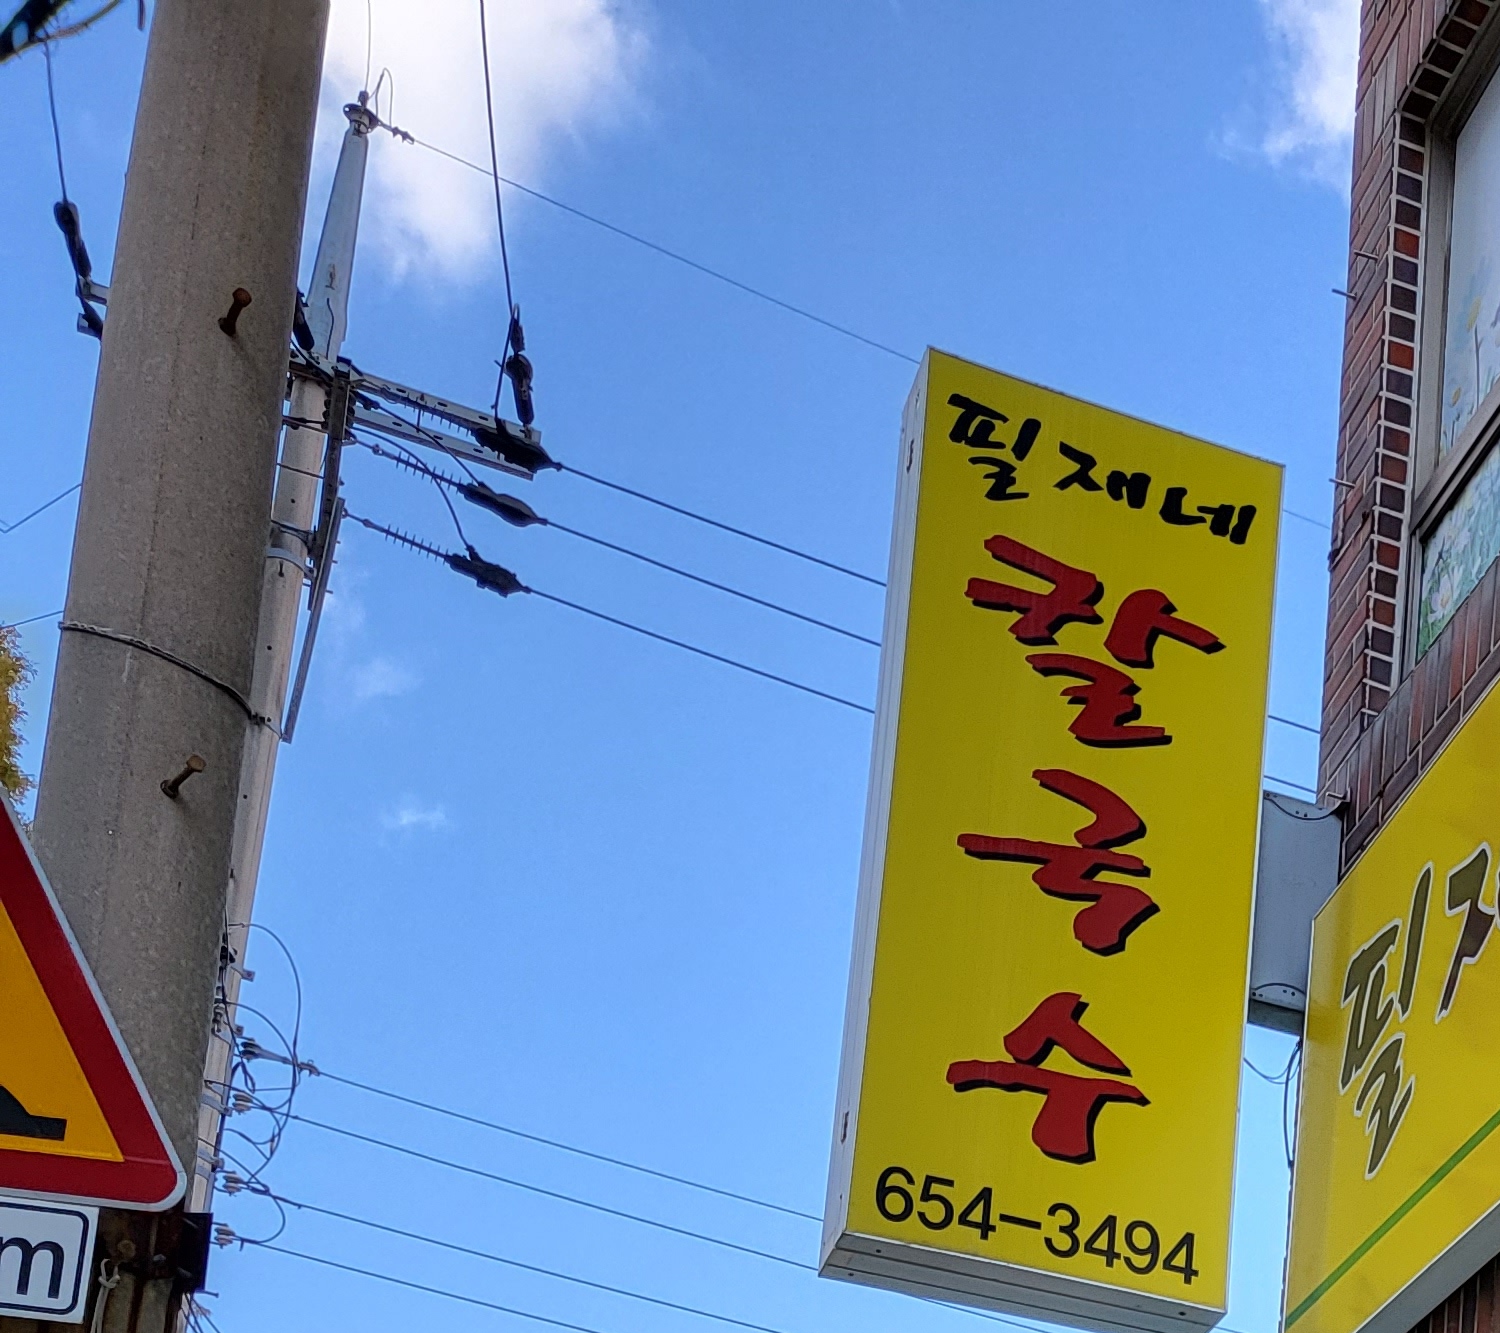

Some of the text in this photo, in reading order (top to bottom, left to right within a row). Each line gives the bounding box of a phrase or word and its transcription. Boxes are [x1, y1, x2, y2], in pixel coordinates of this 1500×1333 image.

[946, 393, 1255, 546] 필재네
[944, 534, 1227, 1166] 칼국수
[874, 1165, 1200, 1285] 654-3494
